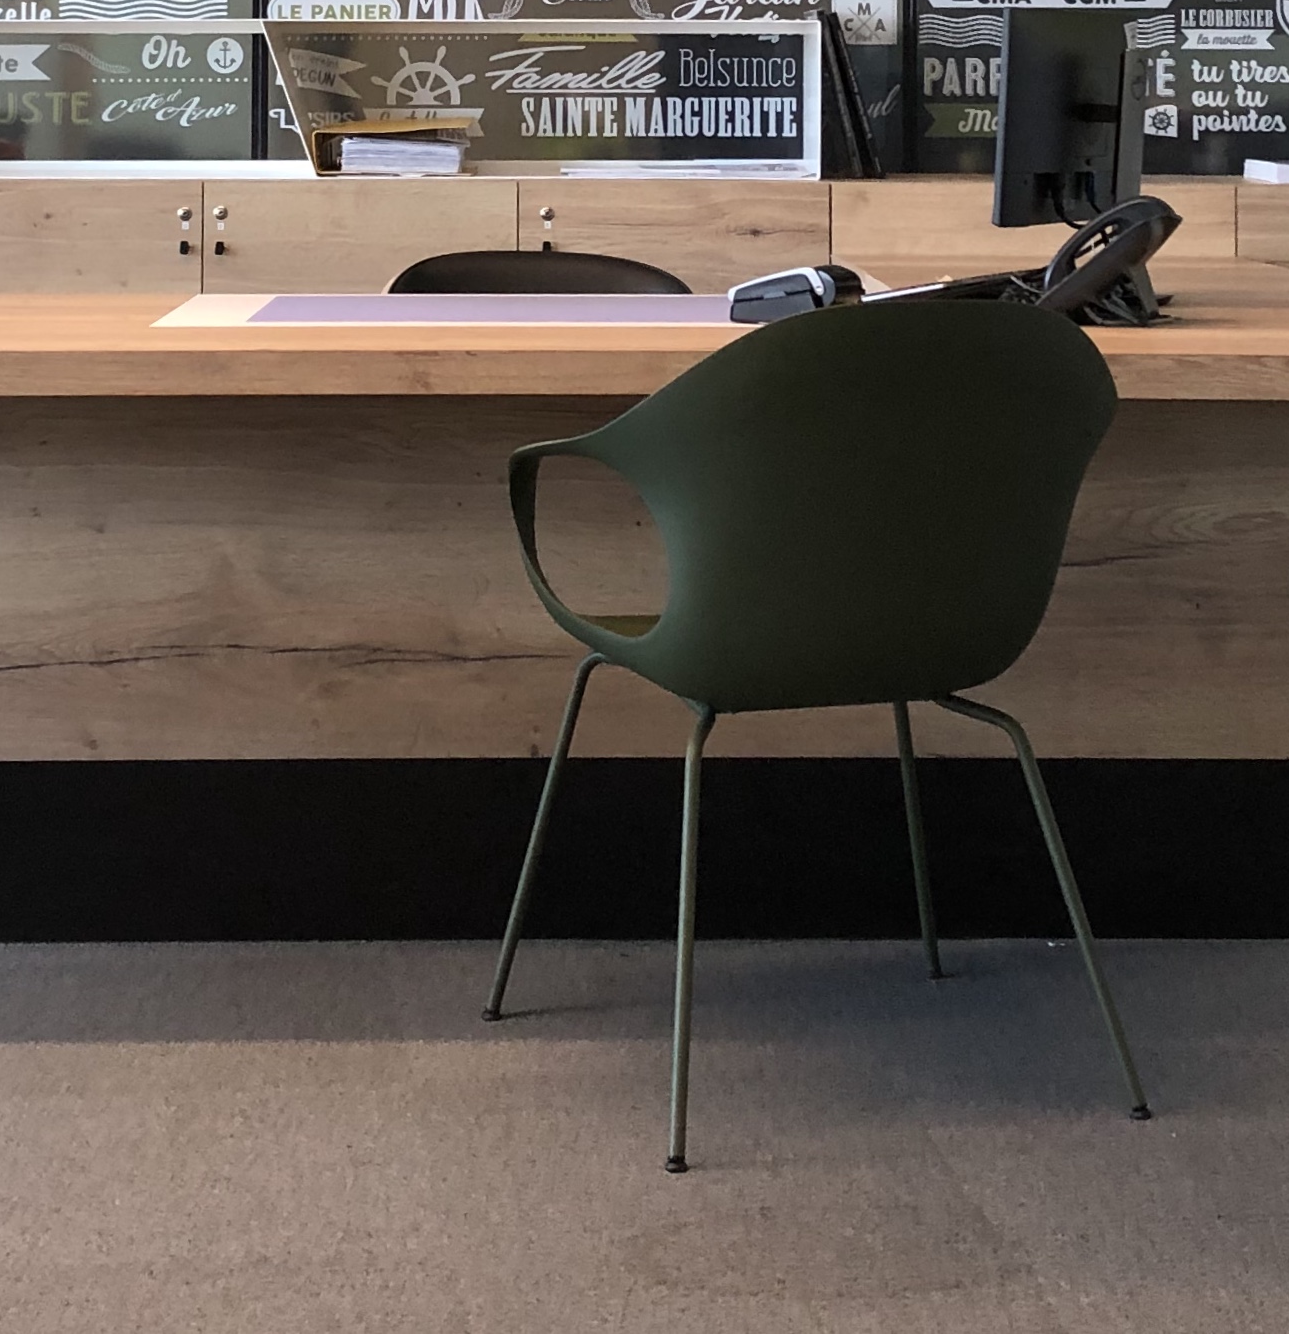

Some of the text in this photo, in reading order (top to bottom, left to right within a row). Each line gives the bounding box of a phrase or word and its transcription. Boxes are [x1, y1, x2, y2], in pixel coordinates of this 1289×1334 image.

[1181, 9, 1275, 28] LE CORBUSIER
[485, 46, 797, 92] Famille Belsunce
[520, 96, 798, 138] SAINTE MARGUERITE
